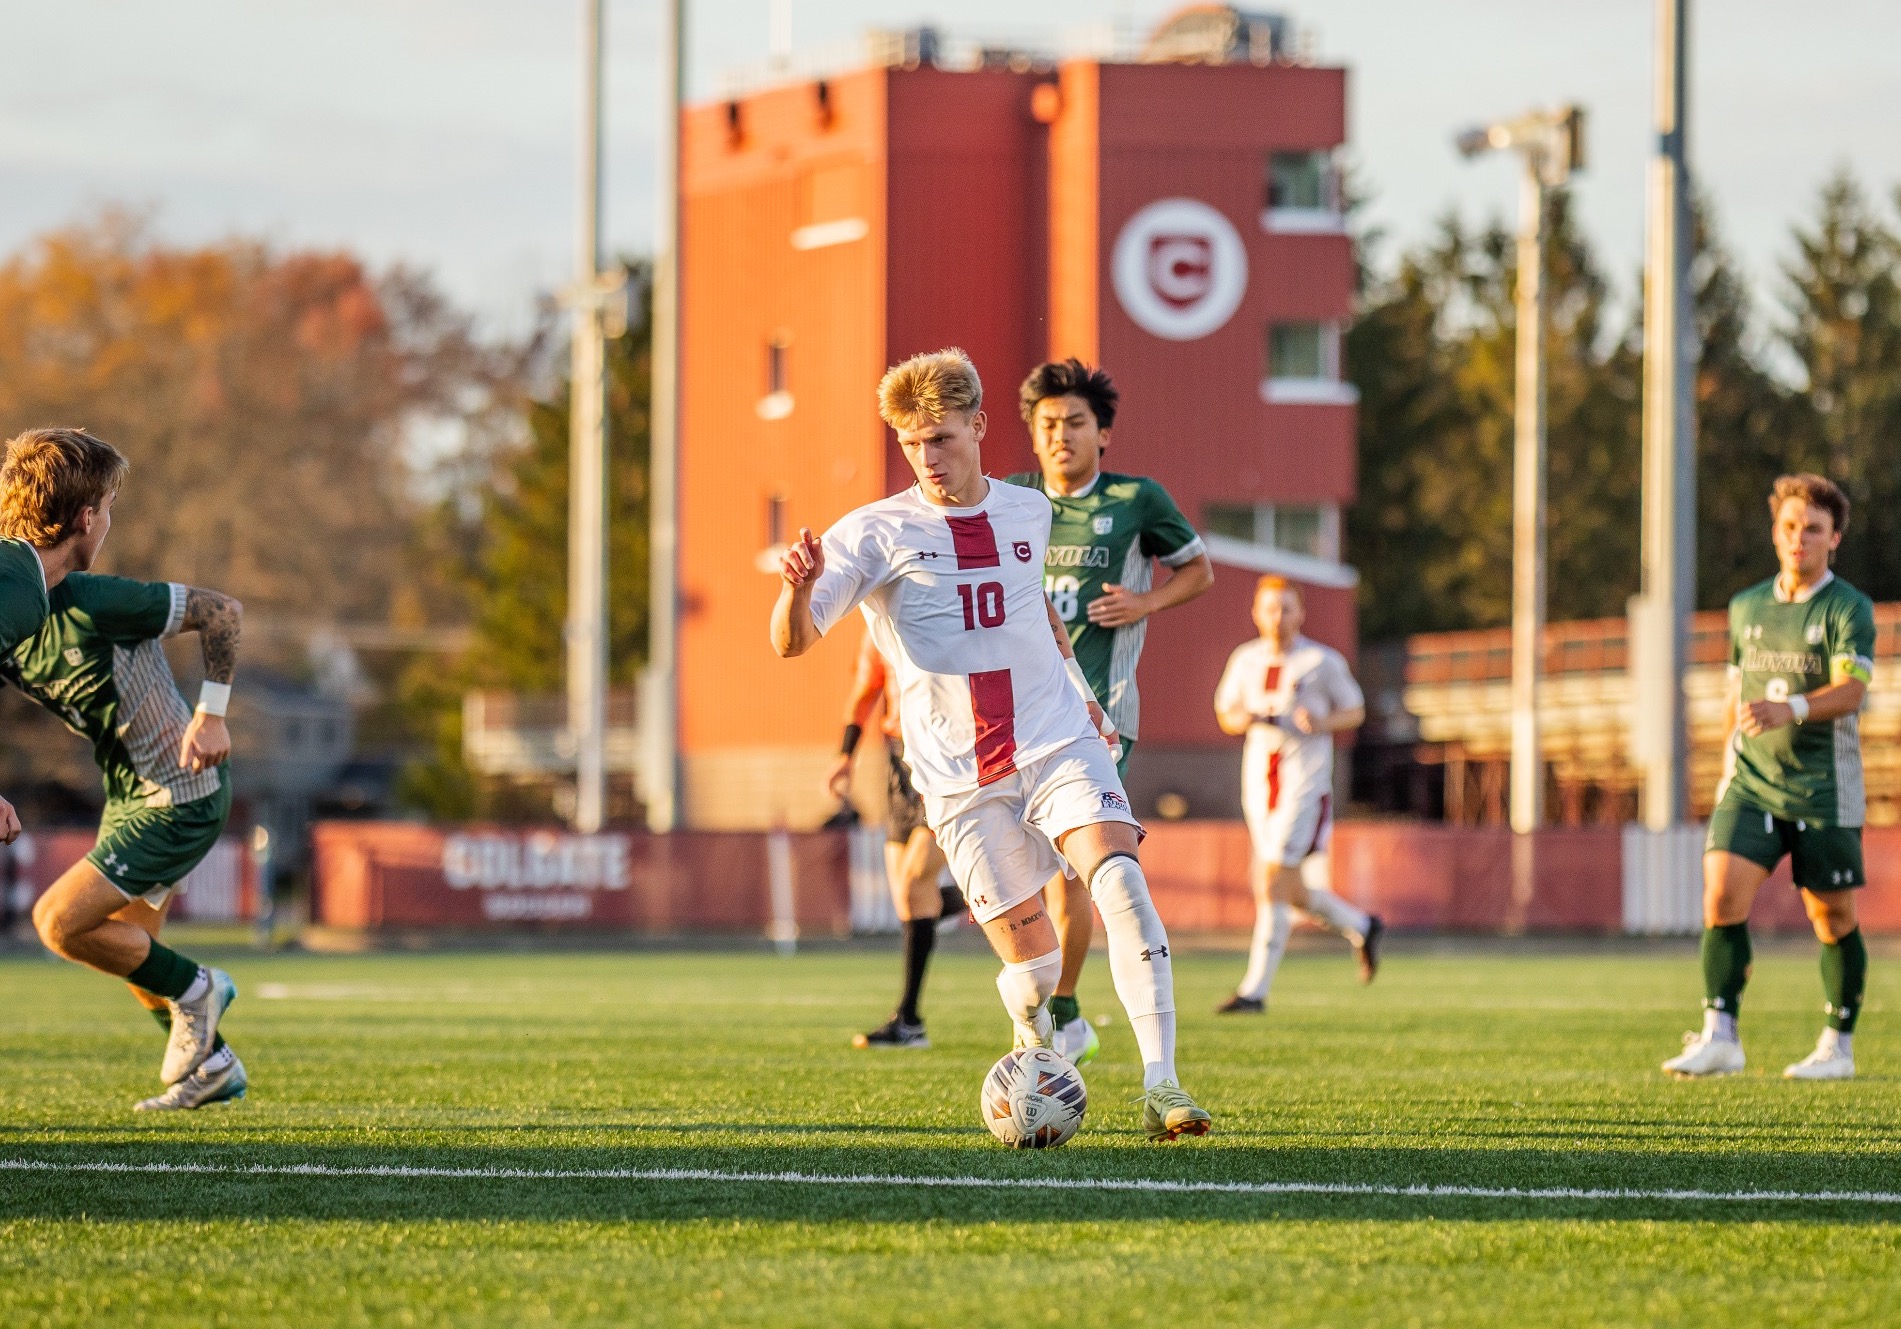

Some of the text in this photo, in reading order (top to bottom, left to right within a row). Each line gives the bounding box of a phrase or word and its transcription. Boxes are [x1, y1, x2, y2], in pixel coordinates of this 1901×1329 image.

[1151, 240, 1209, 298] C
[1017, 545, 1030, 558] C
[1045, 545, 1109, 568] YOLA
[957, 581, 1006, 631] 10
